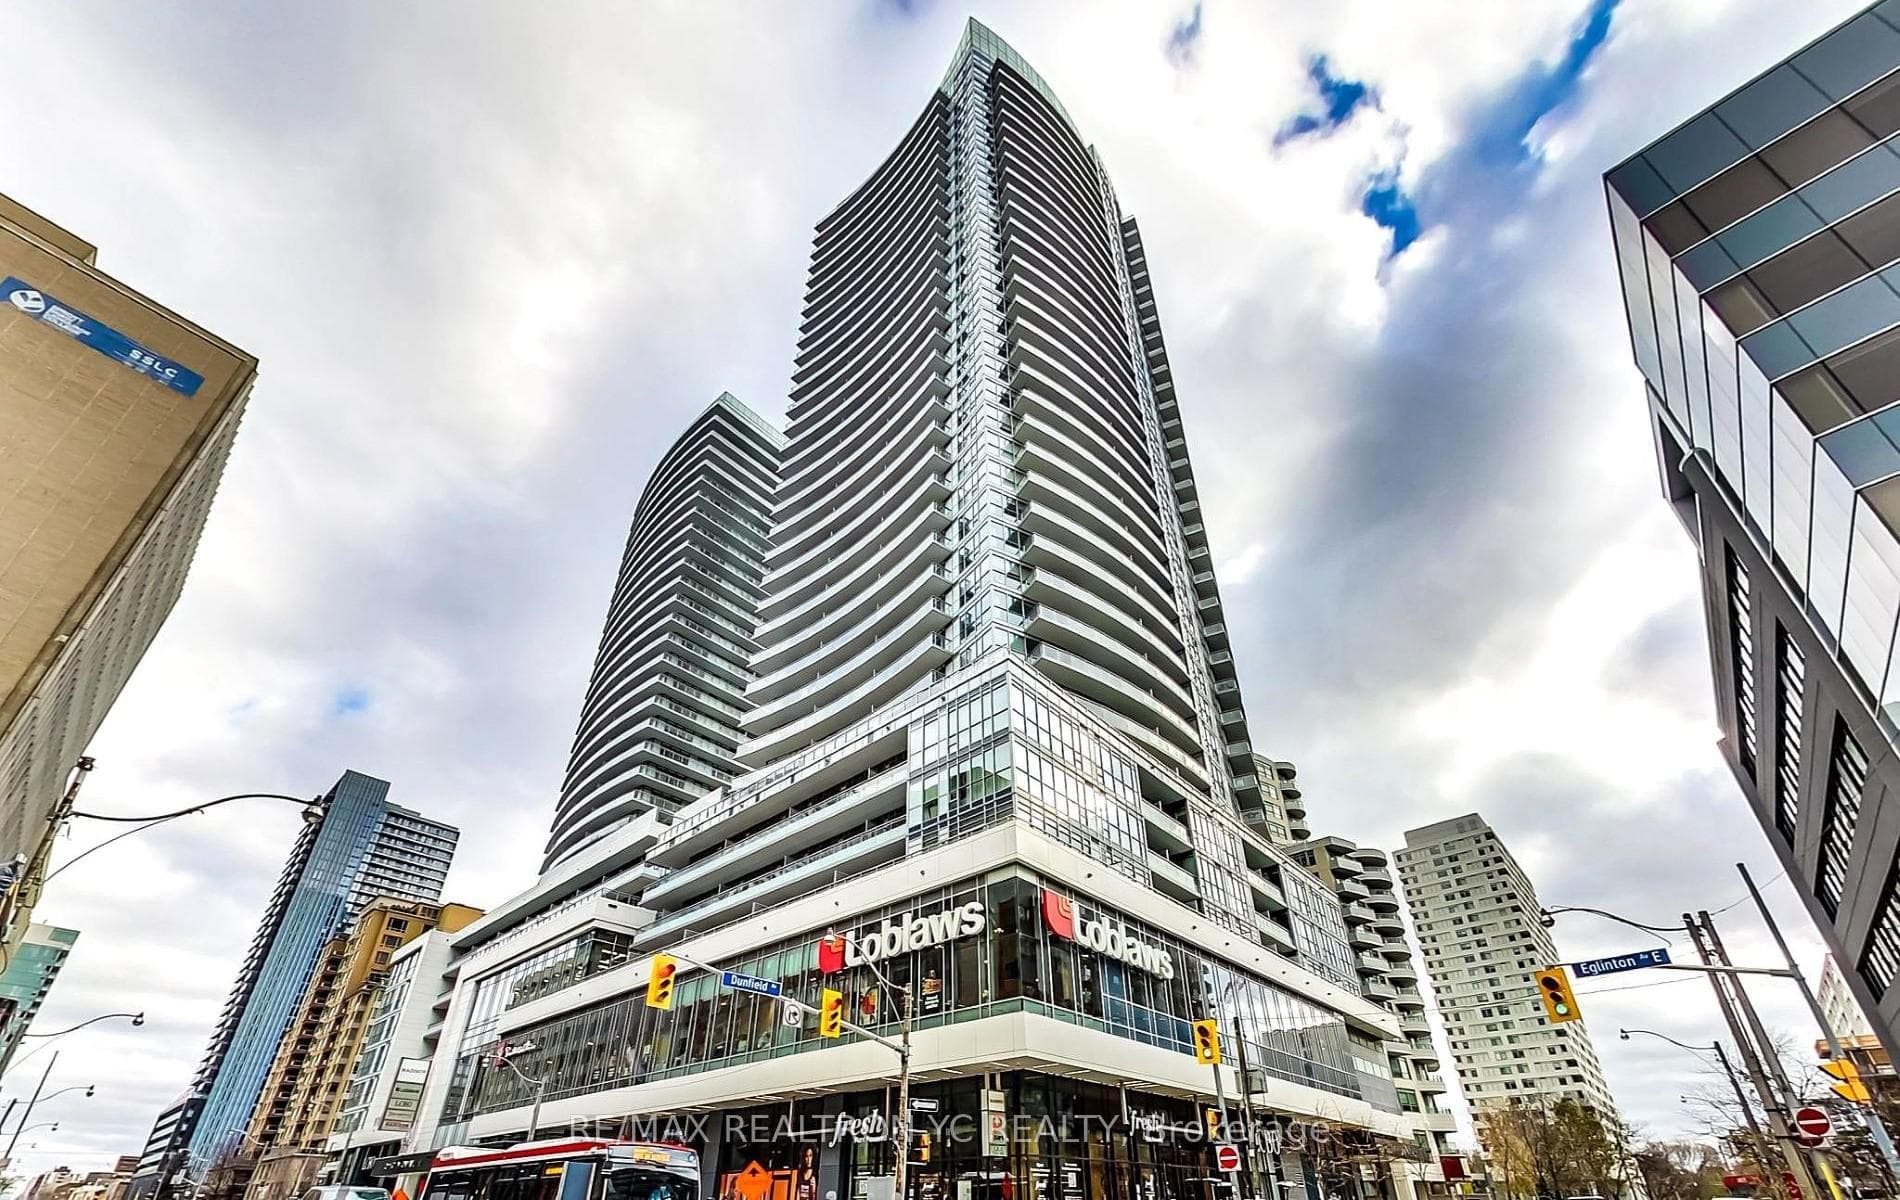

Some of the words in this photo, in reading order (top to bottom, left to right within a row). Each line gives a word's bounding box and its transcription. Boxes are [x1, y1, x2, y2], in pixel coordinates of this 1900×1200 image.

[129, 349, 178, 378] SSLC
[845, 901, 986, 968] Loblaws
[1072, 901, 1174, 981] Loblaws
[1580, 957, 1636, 975] Eglinton
[1651, 951, 1663, 963] E
[731, 974, 768, 992] Dunfield
[828, 1108, 884, 1148] fresh
